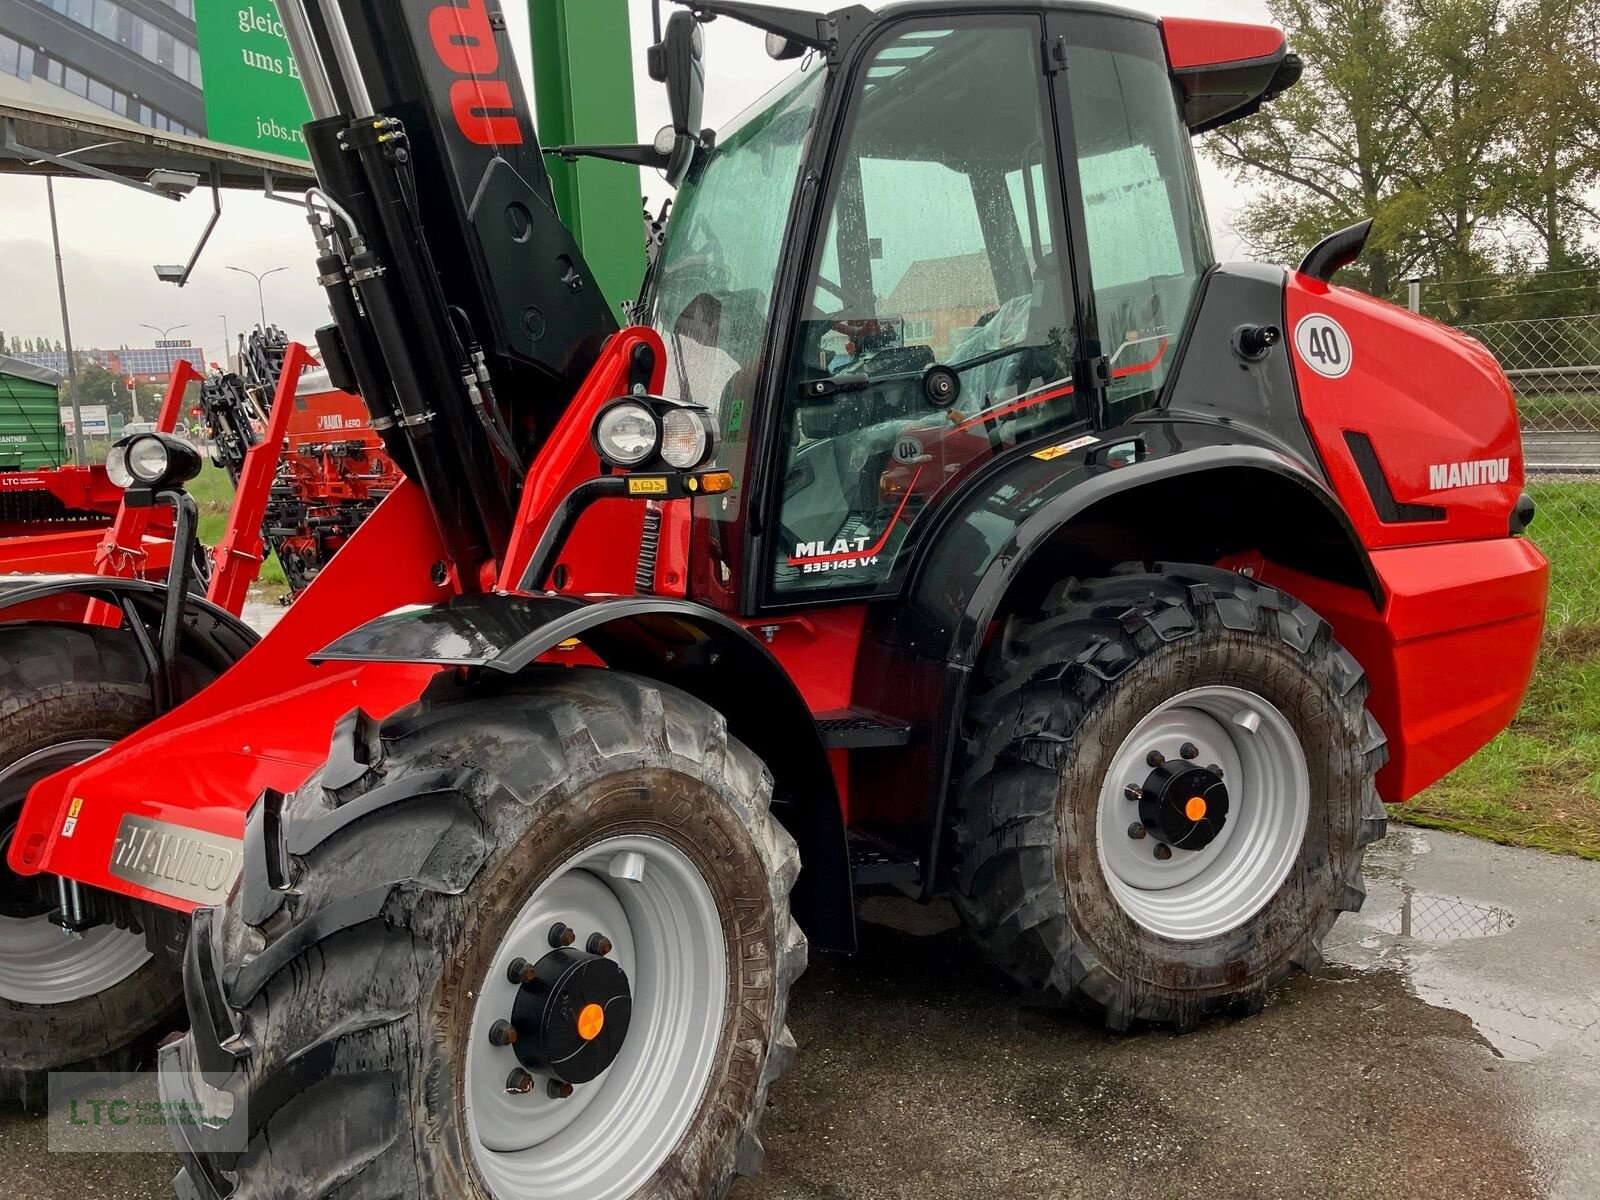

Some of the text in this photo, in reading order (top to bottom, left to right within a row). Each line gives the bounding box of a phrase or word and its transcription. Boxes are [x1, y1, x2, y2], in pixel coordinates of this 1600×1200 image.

[238, 6, 287, 39] gleic
[241, 48, 283, 75] ums
[1310, 326, 1341, 365] 40
[345, 418, 361, 429] AERO
[2, 478, 19, 486] LTC
[1429, 457, 1510, 491] MANITOU
[795, 536, 871, 559] MLA-T
[860, 555, 879, 567] V+
